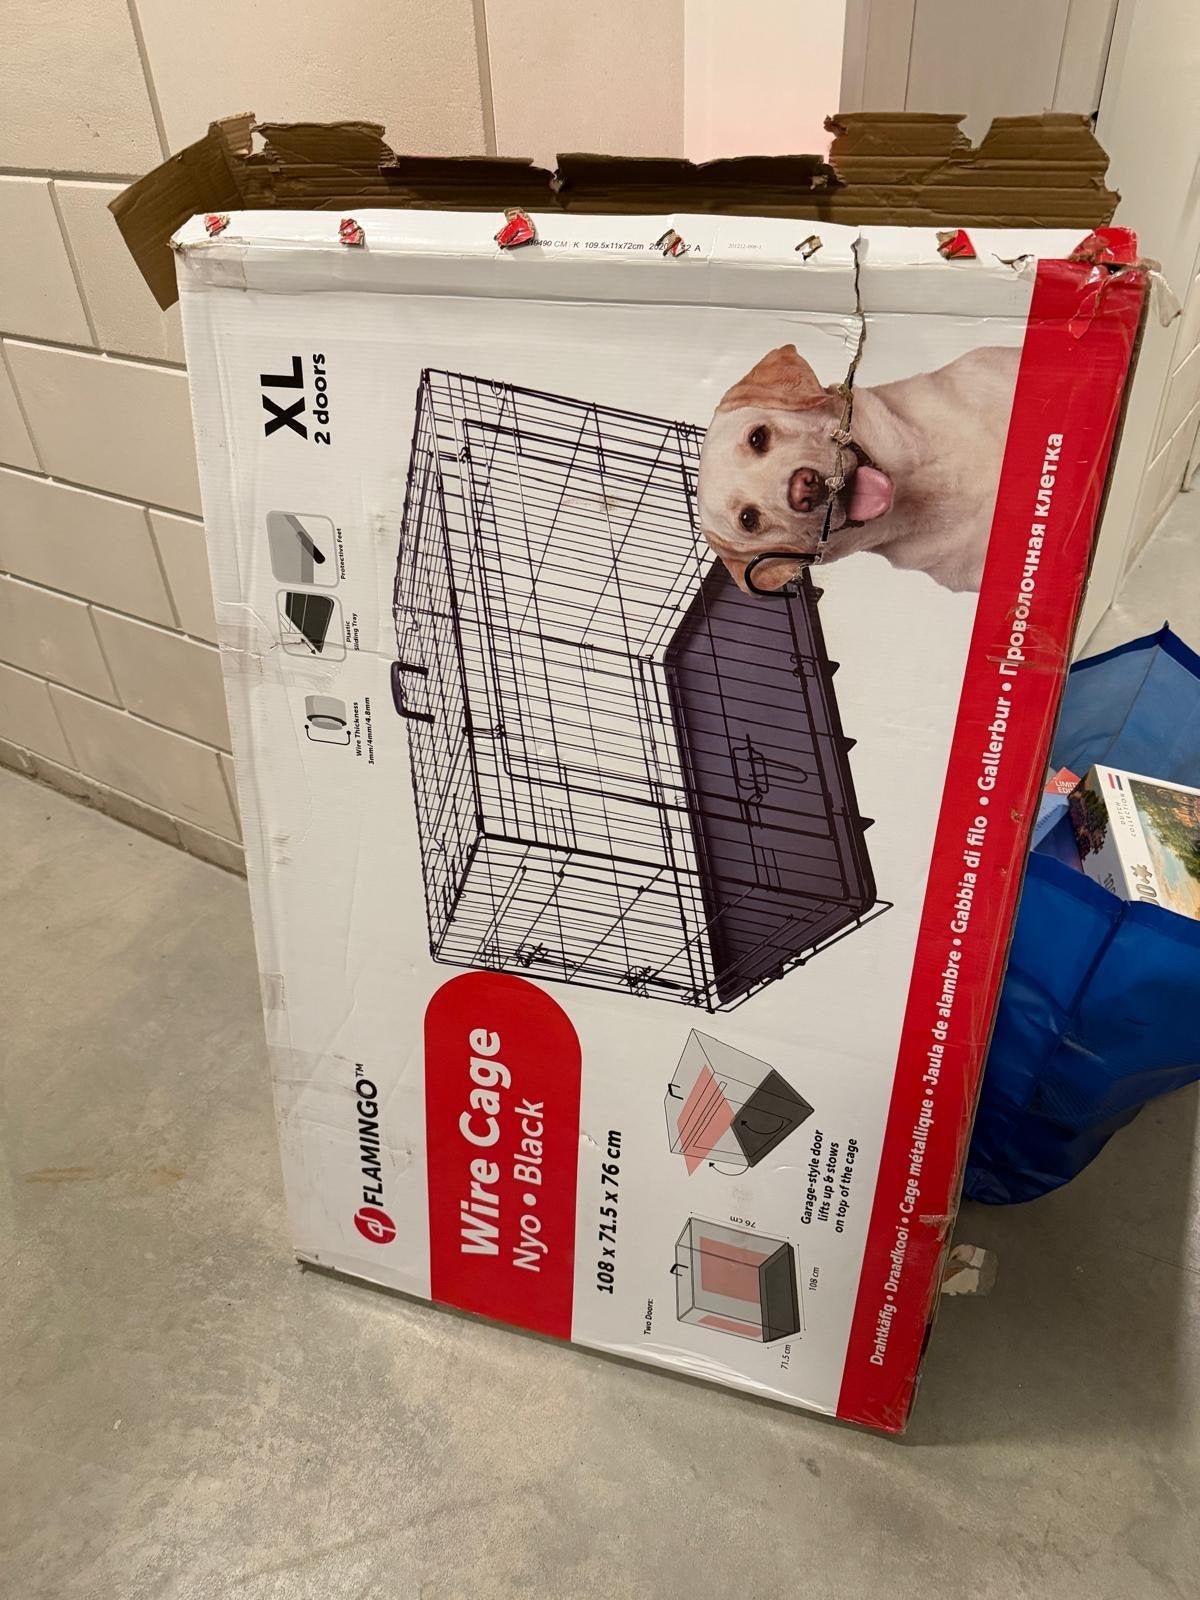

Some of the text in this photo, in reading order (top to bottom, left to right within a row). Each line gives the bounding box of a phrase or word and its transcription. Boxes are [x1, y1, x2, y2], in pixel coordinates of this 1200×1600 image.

[584, 241, 644, 250] 109.5x11x72cm
[259, 355, 308, 441] XL
[309, 353, 331, 446] 2 doors
[336, 527, 347, 581] Protective Feet
[998, 432, 1064, 677] Проволочная клетка
[344, 620, 352, 643] Plastic
[351, 612, 361, 652] Sliding Tray
[352, 701, 363, 758] Wire Thickness
[363, 696, 375, 766] 3mm/4mm/4.8mm
[869, 692, 1013, 1367] Drahtkäfig Draadkooi Cage métallique Jaula de alambre Gabbia di filo Gallerbur
[458, 1028, 512, 1256] Wire Cage
[800, 1129, 824, 1225] Garage-style door
[512, 1097, 549, 1273] Nyo Black
[596, 1129, 622, 1295] 108 x 71.5 x 76 cm
[816, 1141, 839, 1222] lifts up & stows
[834, 1138, 859, 1233] on top of the cage
[729, 1215, 757, 1229] 76 cm
[807, 1266, 821, 1292] 108 cm
[643, 1298, 655, 1336] Two Doors:
[780, 1344, 792, 1370] 71.5 cm
